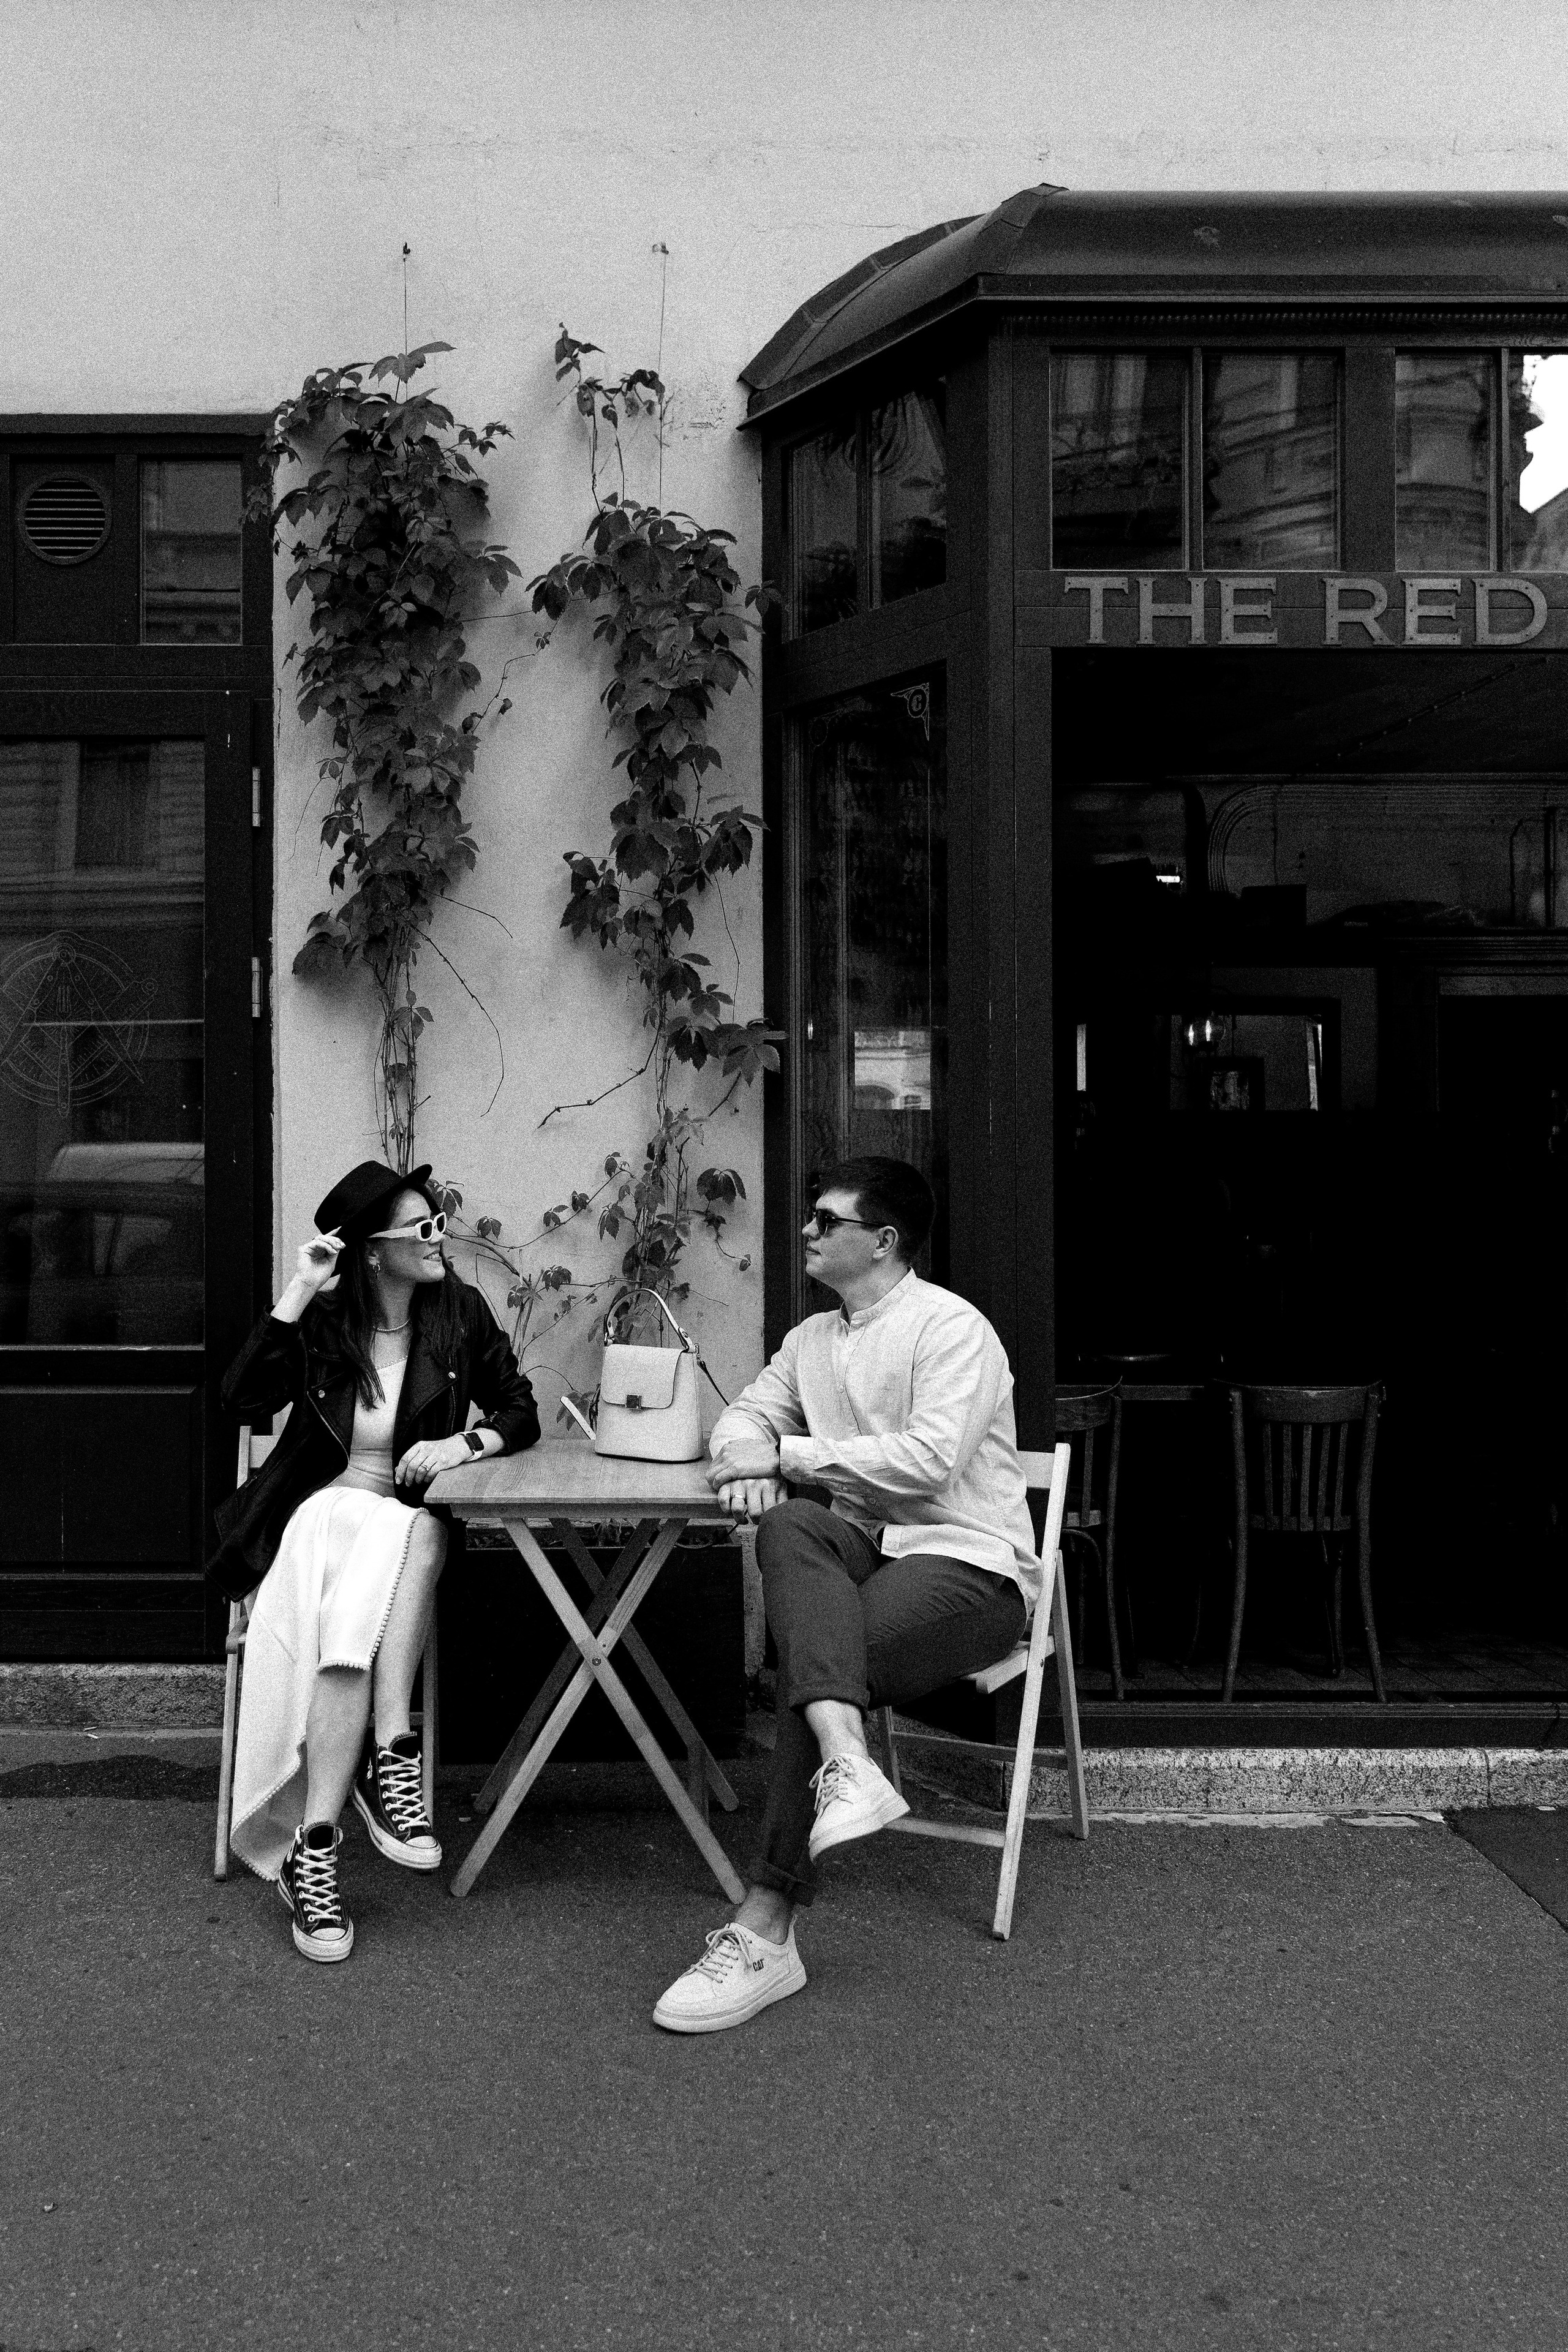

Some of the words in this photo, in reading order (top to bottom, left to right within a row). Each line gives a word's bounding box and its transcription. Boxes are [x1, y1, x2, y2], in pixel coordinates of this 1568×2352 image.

[1065, 576, 1278, 644] THE
[1323, 577, 1548, 646] RED
[752, 1958, 765, 1972] CAT
